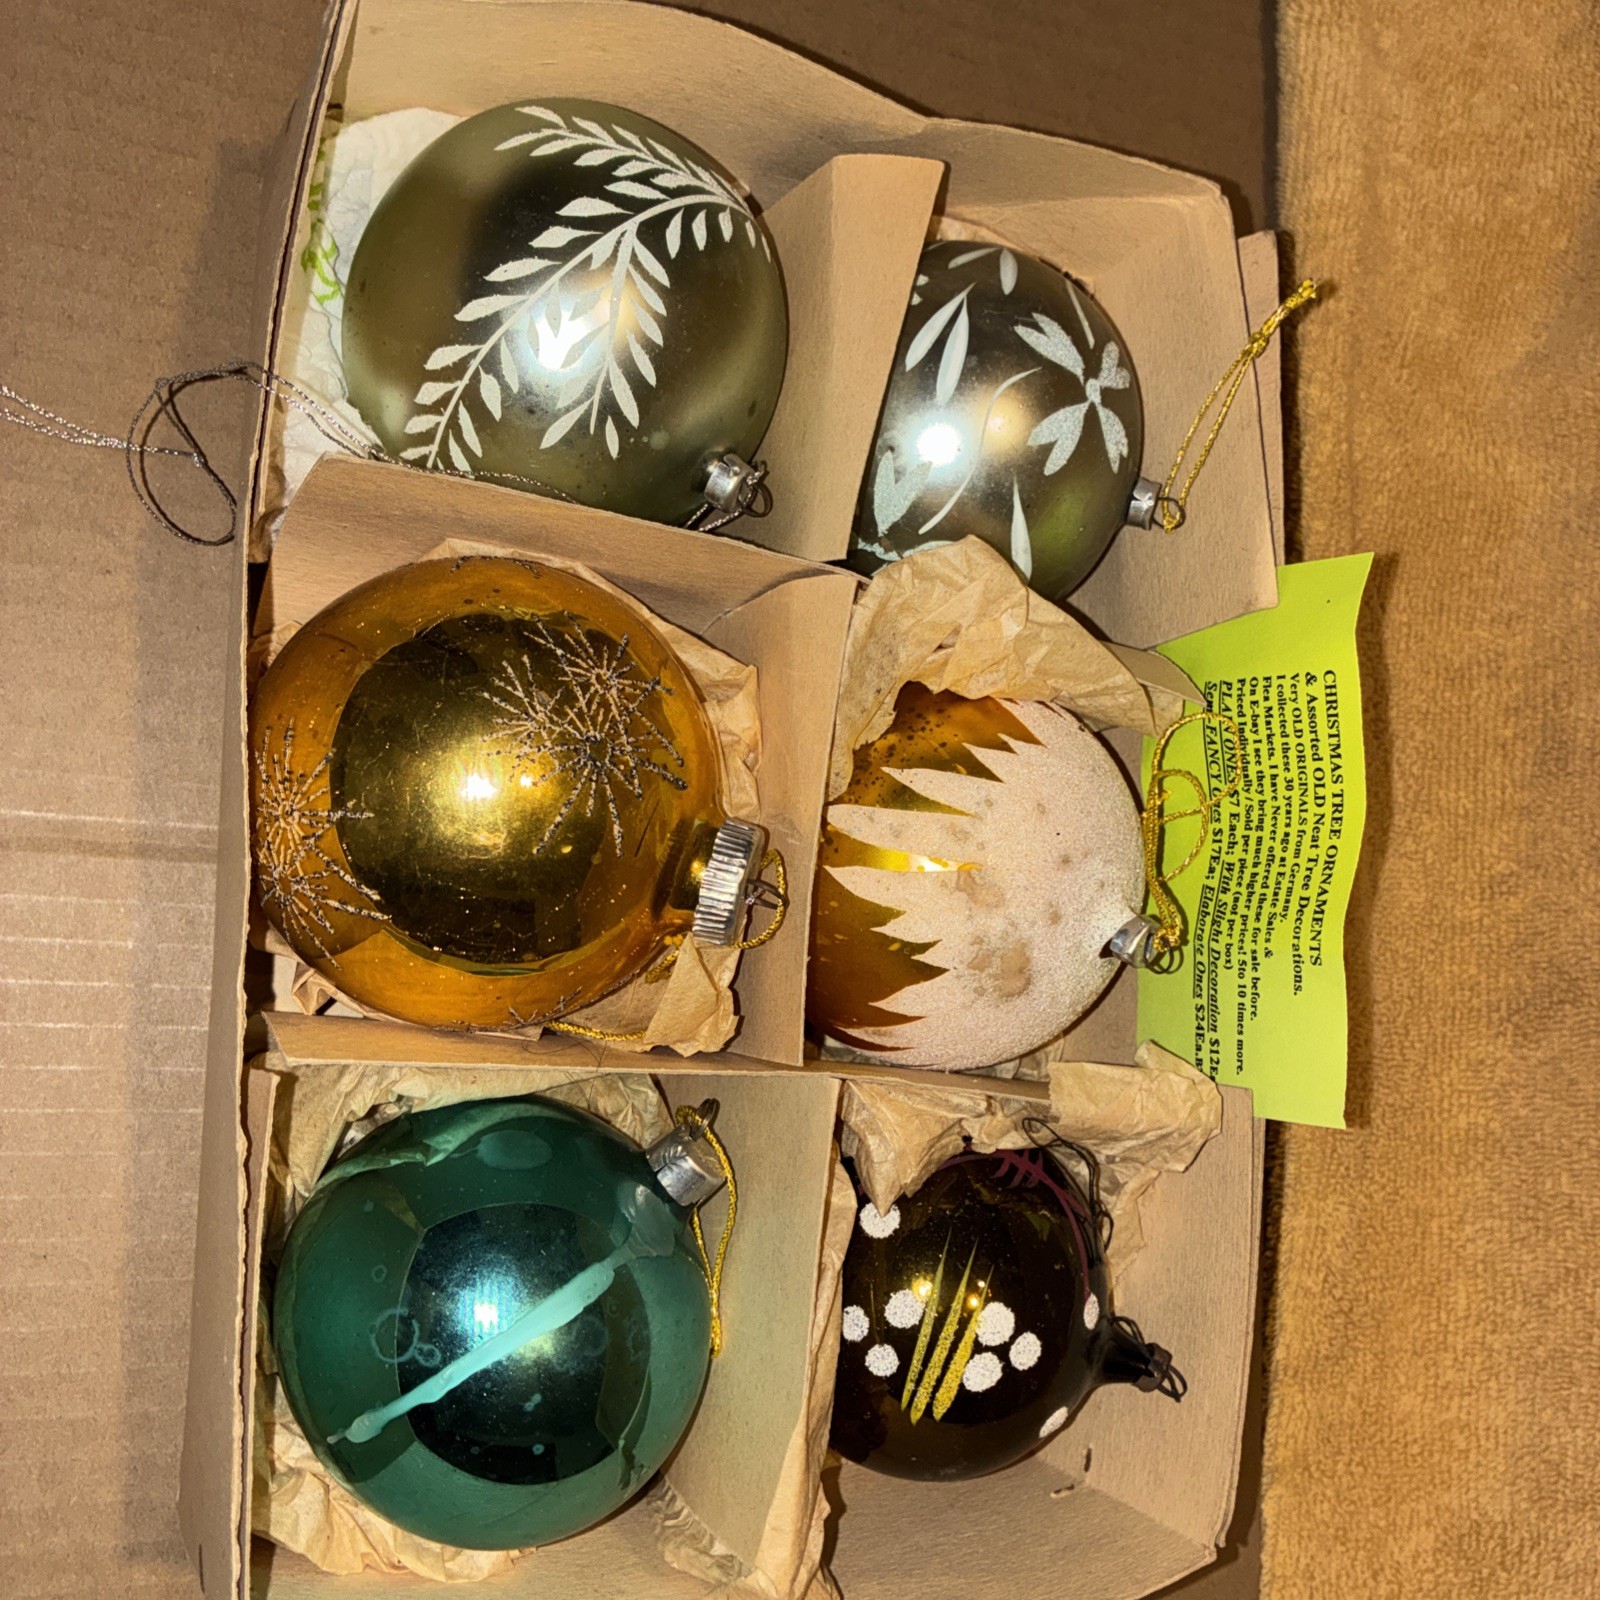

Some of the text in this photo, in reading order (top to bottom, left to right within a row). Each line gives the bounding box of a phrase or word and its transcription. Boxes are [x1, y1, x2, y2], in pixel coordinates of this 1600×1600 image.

[1237, 678, 1246, 718] Priced
[1249, 677, 1259, 696] On
[1263, 676, 1272, 702] Flea
[1250, 700, 1260, 735] E-bay
[1277, 684, 1289, 738] collected
[1206, 682, 1222, 783] Sem-FANCY
[1264, 706, 1277, 761] Markets.
[1238, 722, 1253, 794] Individually
[1254, 748, 1262, 766] see
[1281, 742, 1291, 773] these
[1255, 770, 1265, 796] they
[1270, 774, 1279, 802] have
[1279, 673, 1308, 923] Very OLD ORIGINALS from Germany.
[1285, 777, 1294, 791] 30
[1244, 804, 1254, 830] Sold
[1255, 800, 1267, 833] bring
[1269, 806, 1280, 842] Never
[1283, 796, 1292, 828] years
[1310, 670, 1343, 966] CHRISTMAS TREE ORNAMENTS
[1225, 812, 1240, 855] Each;
[1241, 835, 1250, 855] per
[1280, 831, 1290, 853] ago
[1292, 672, 1326, 996] & Assorted OLD Neat Tree Decorations.
[1252, 836, 1265, 868] much
[1260, 846, 1276, 889] offered
[1279, 857, 1288, 868] at
[1220, 861, 1235, 895] With
[1236, 858, 1247, 888] piece
[1231, 891, 1242, 916] (not
[1244, 872, 1259, 911] higher
[1270, 872, 1286, 909] Estate
[1196, 884, 1215, 956] Elaborate
[1211, 899, 1228, 944] Slight
[1254, 893, 1267, 923] these
[1226, 919, 1236, 939] per
[1237, 914, 1249, 955] prices!
[1251, 927, 1261, 945] for
[1265, 912, 1277, 944] Sales
[1223, 943, 1234, 970] box)
[1238, 959, 1247, 979] 5to
[1251, 949, 1260, 973] sale
[1264, 947, 1273, 959] &
[1196, 961, 1206, 999] Ones
[1210, 948, 1221, 1033] Decoration
[1238, 984, 1246, 998] 10
[1250, 977, 1261, 1021] before.
[1237, 1002, 1246, 1035] times
[1236, 1039, 1244, 1075] more.
